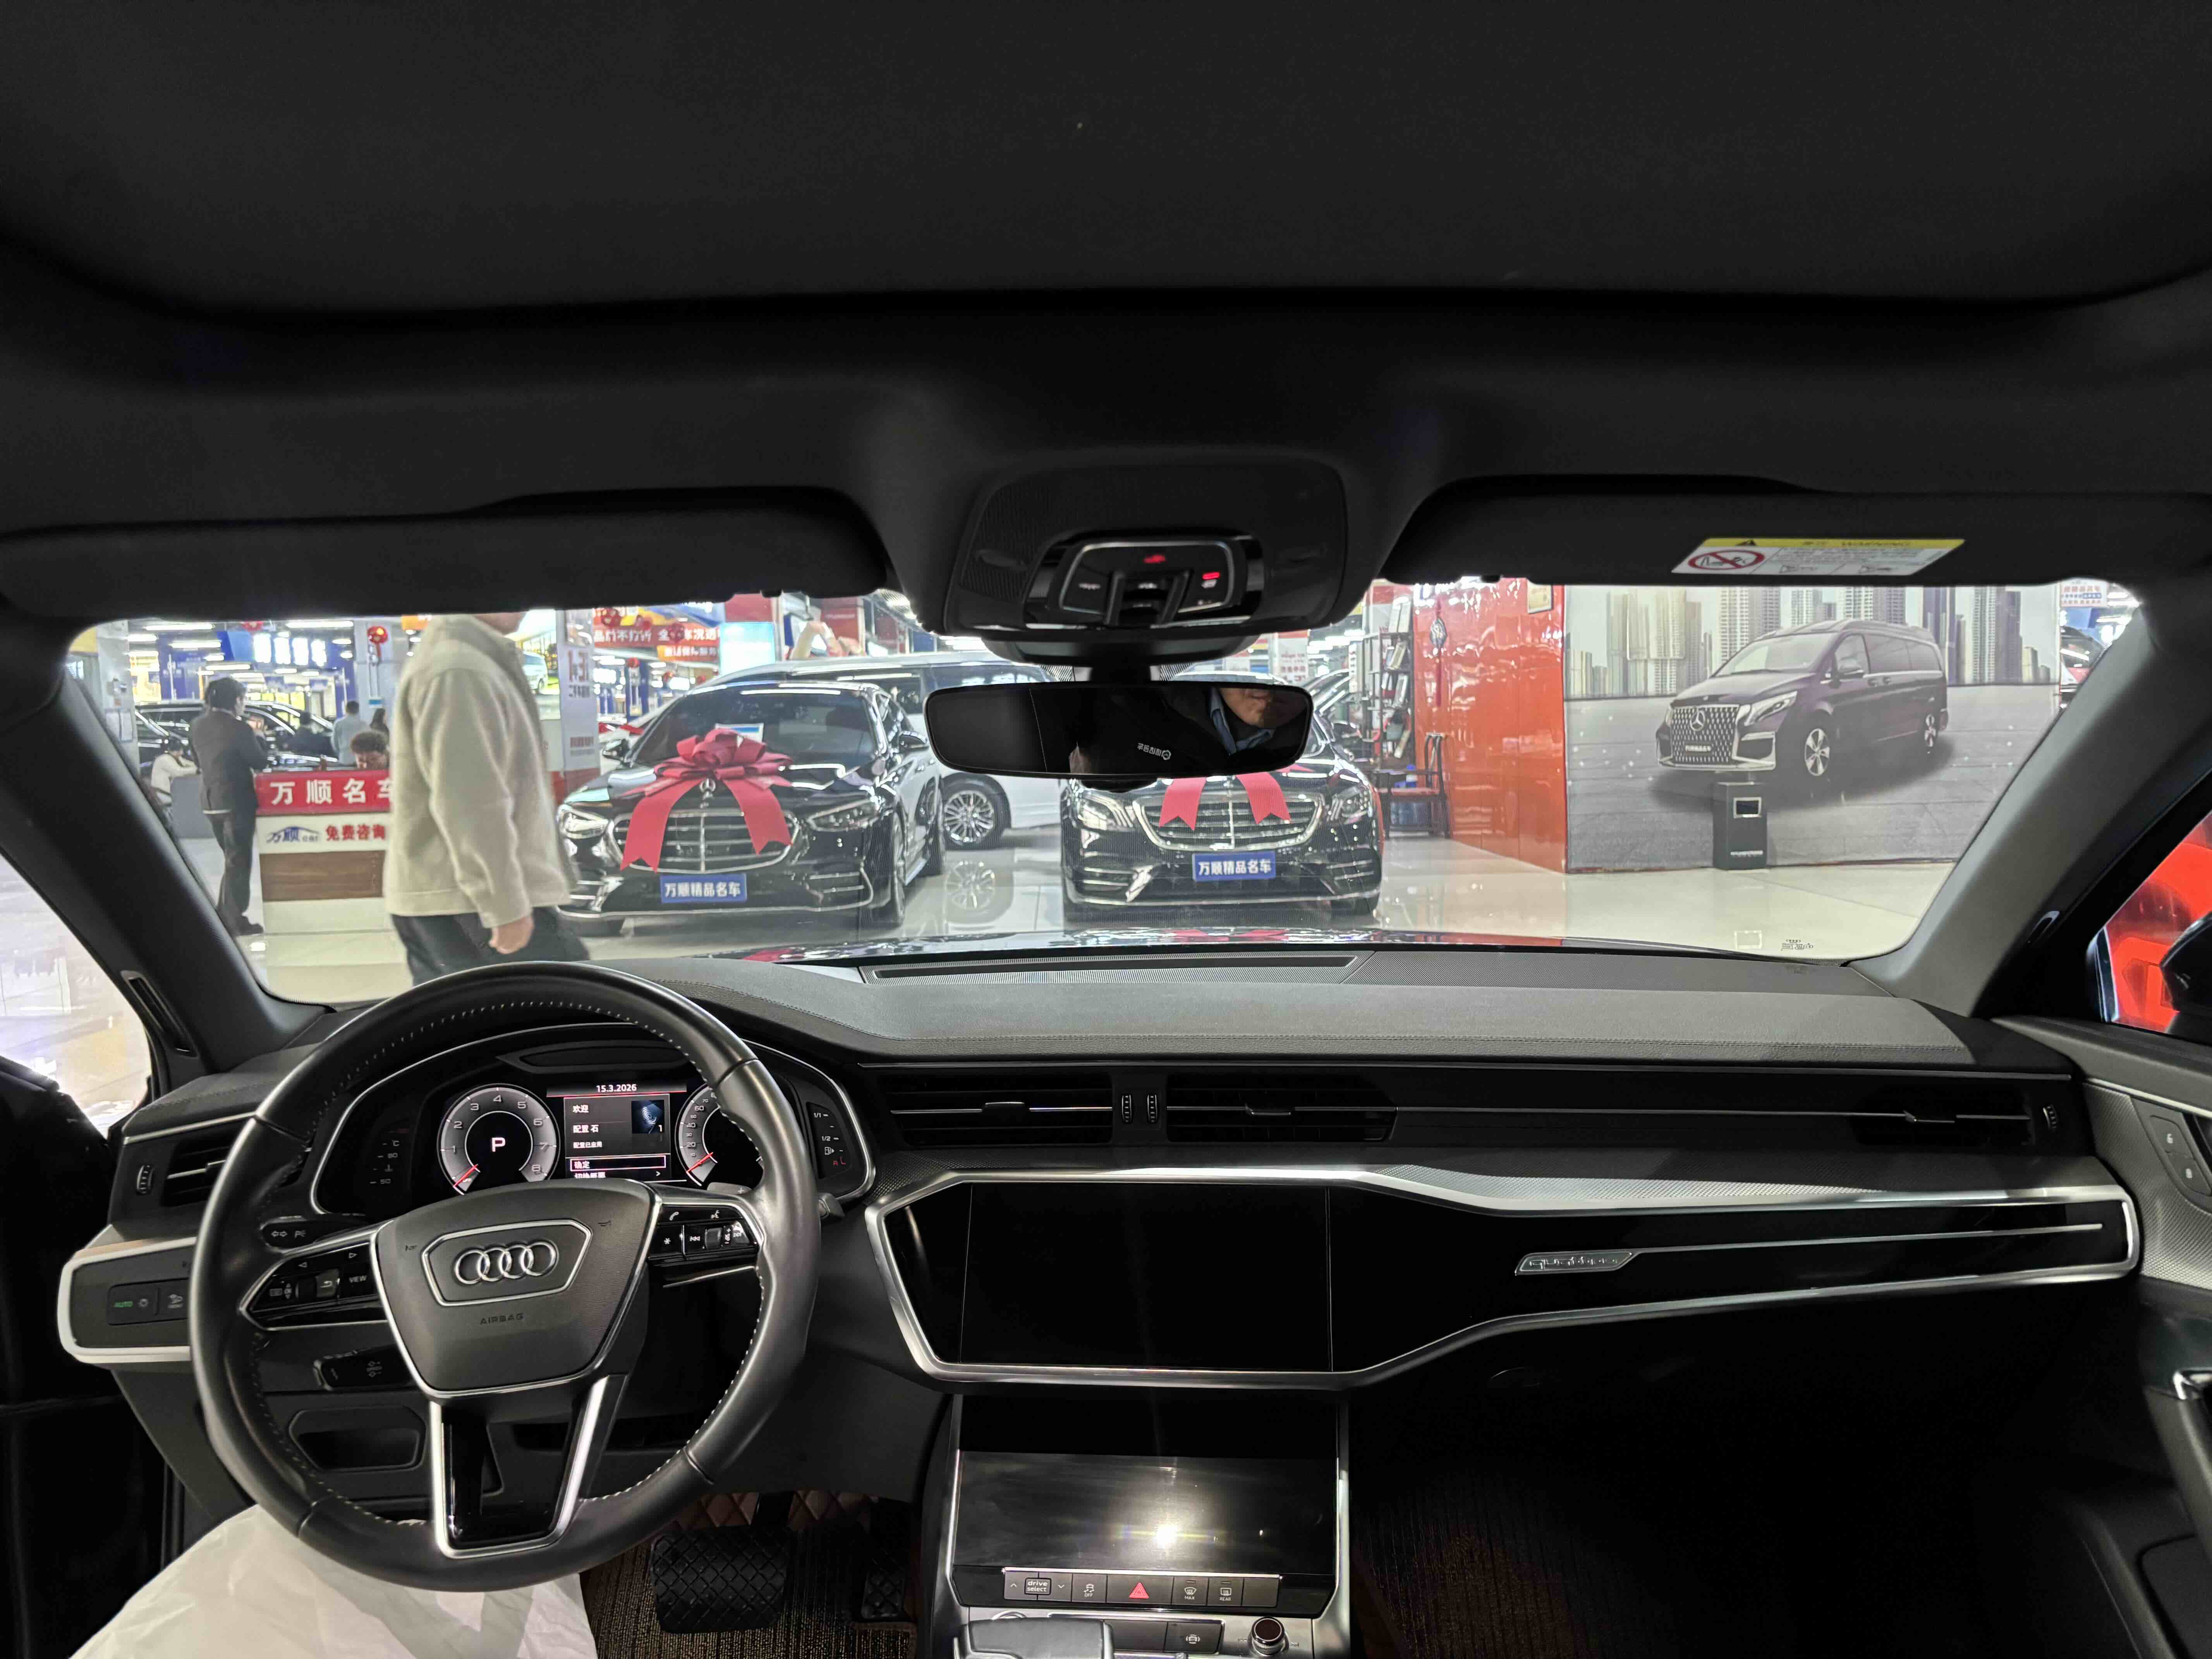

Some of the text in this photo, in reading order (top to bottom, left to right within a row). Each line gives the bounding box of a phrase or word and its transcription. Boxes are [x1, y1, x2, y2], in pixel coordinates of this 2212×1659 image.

[325, 824, 386, 841] 免费咨询
[1198, 858, 1272, 876] 万顺精品名车
[664, 882, 741, 898] 万顺精品名车
[596, 1084, 637, 1092] 15.3.2026
[573, 1105, 589, 1113] 欢迎
[573, 1125, 599, 1133] 配置 石
[492, 1137, 506, 1152] P
[480, 1313, 524, 1324] AIRBAG
